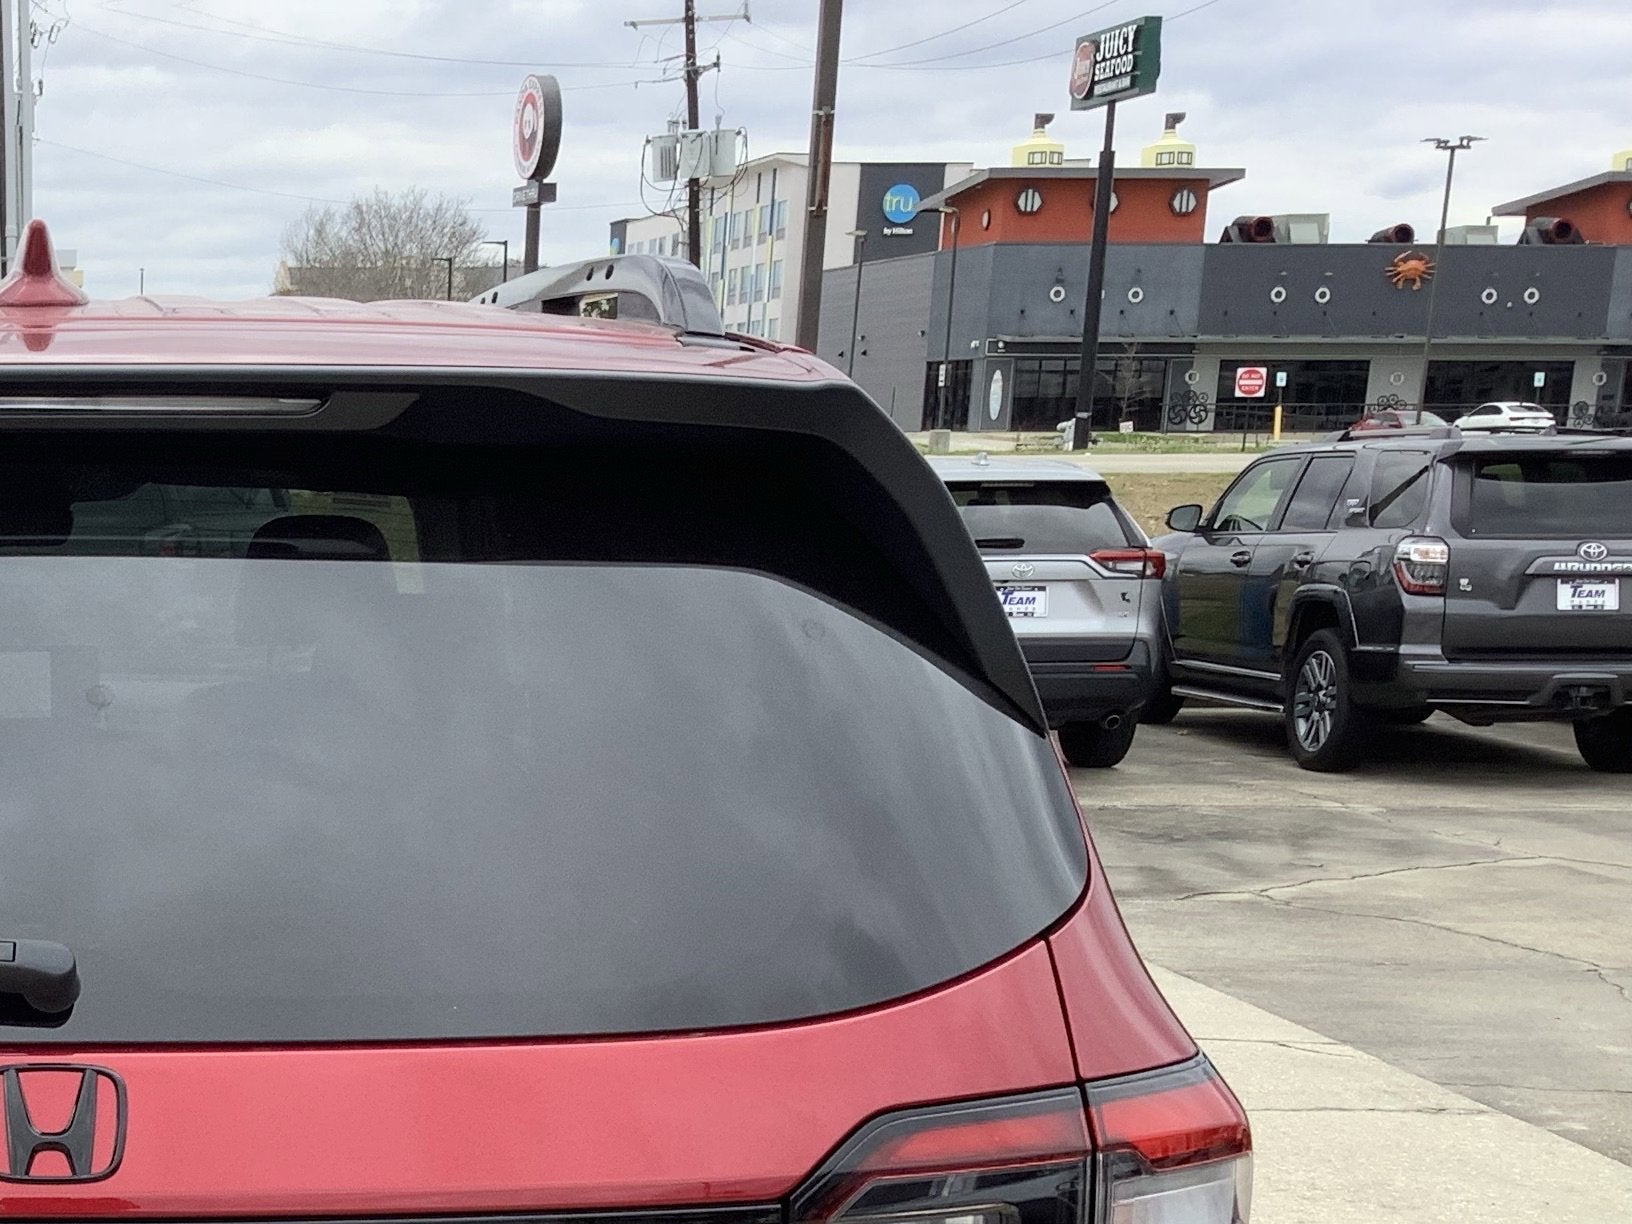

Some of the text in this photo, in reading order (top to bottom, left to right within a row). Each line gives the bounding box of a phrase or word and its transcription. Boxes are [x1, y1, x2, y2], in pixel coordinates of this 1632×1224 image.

[1096, 24, 1137, 62] JUICY
[1094, 54, 1134, 81] SEAFOOD
[883, 191, 914, 213] tru
[1001, 590, 1037, 605] TEAM
[1570, 584, 1606, 598] TEAM
